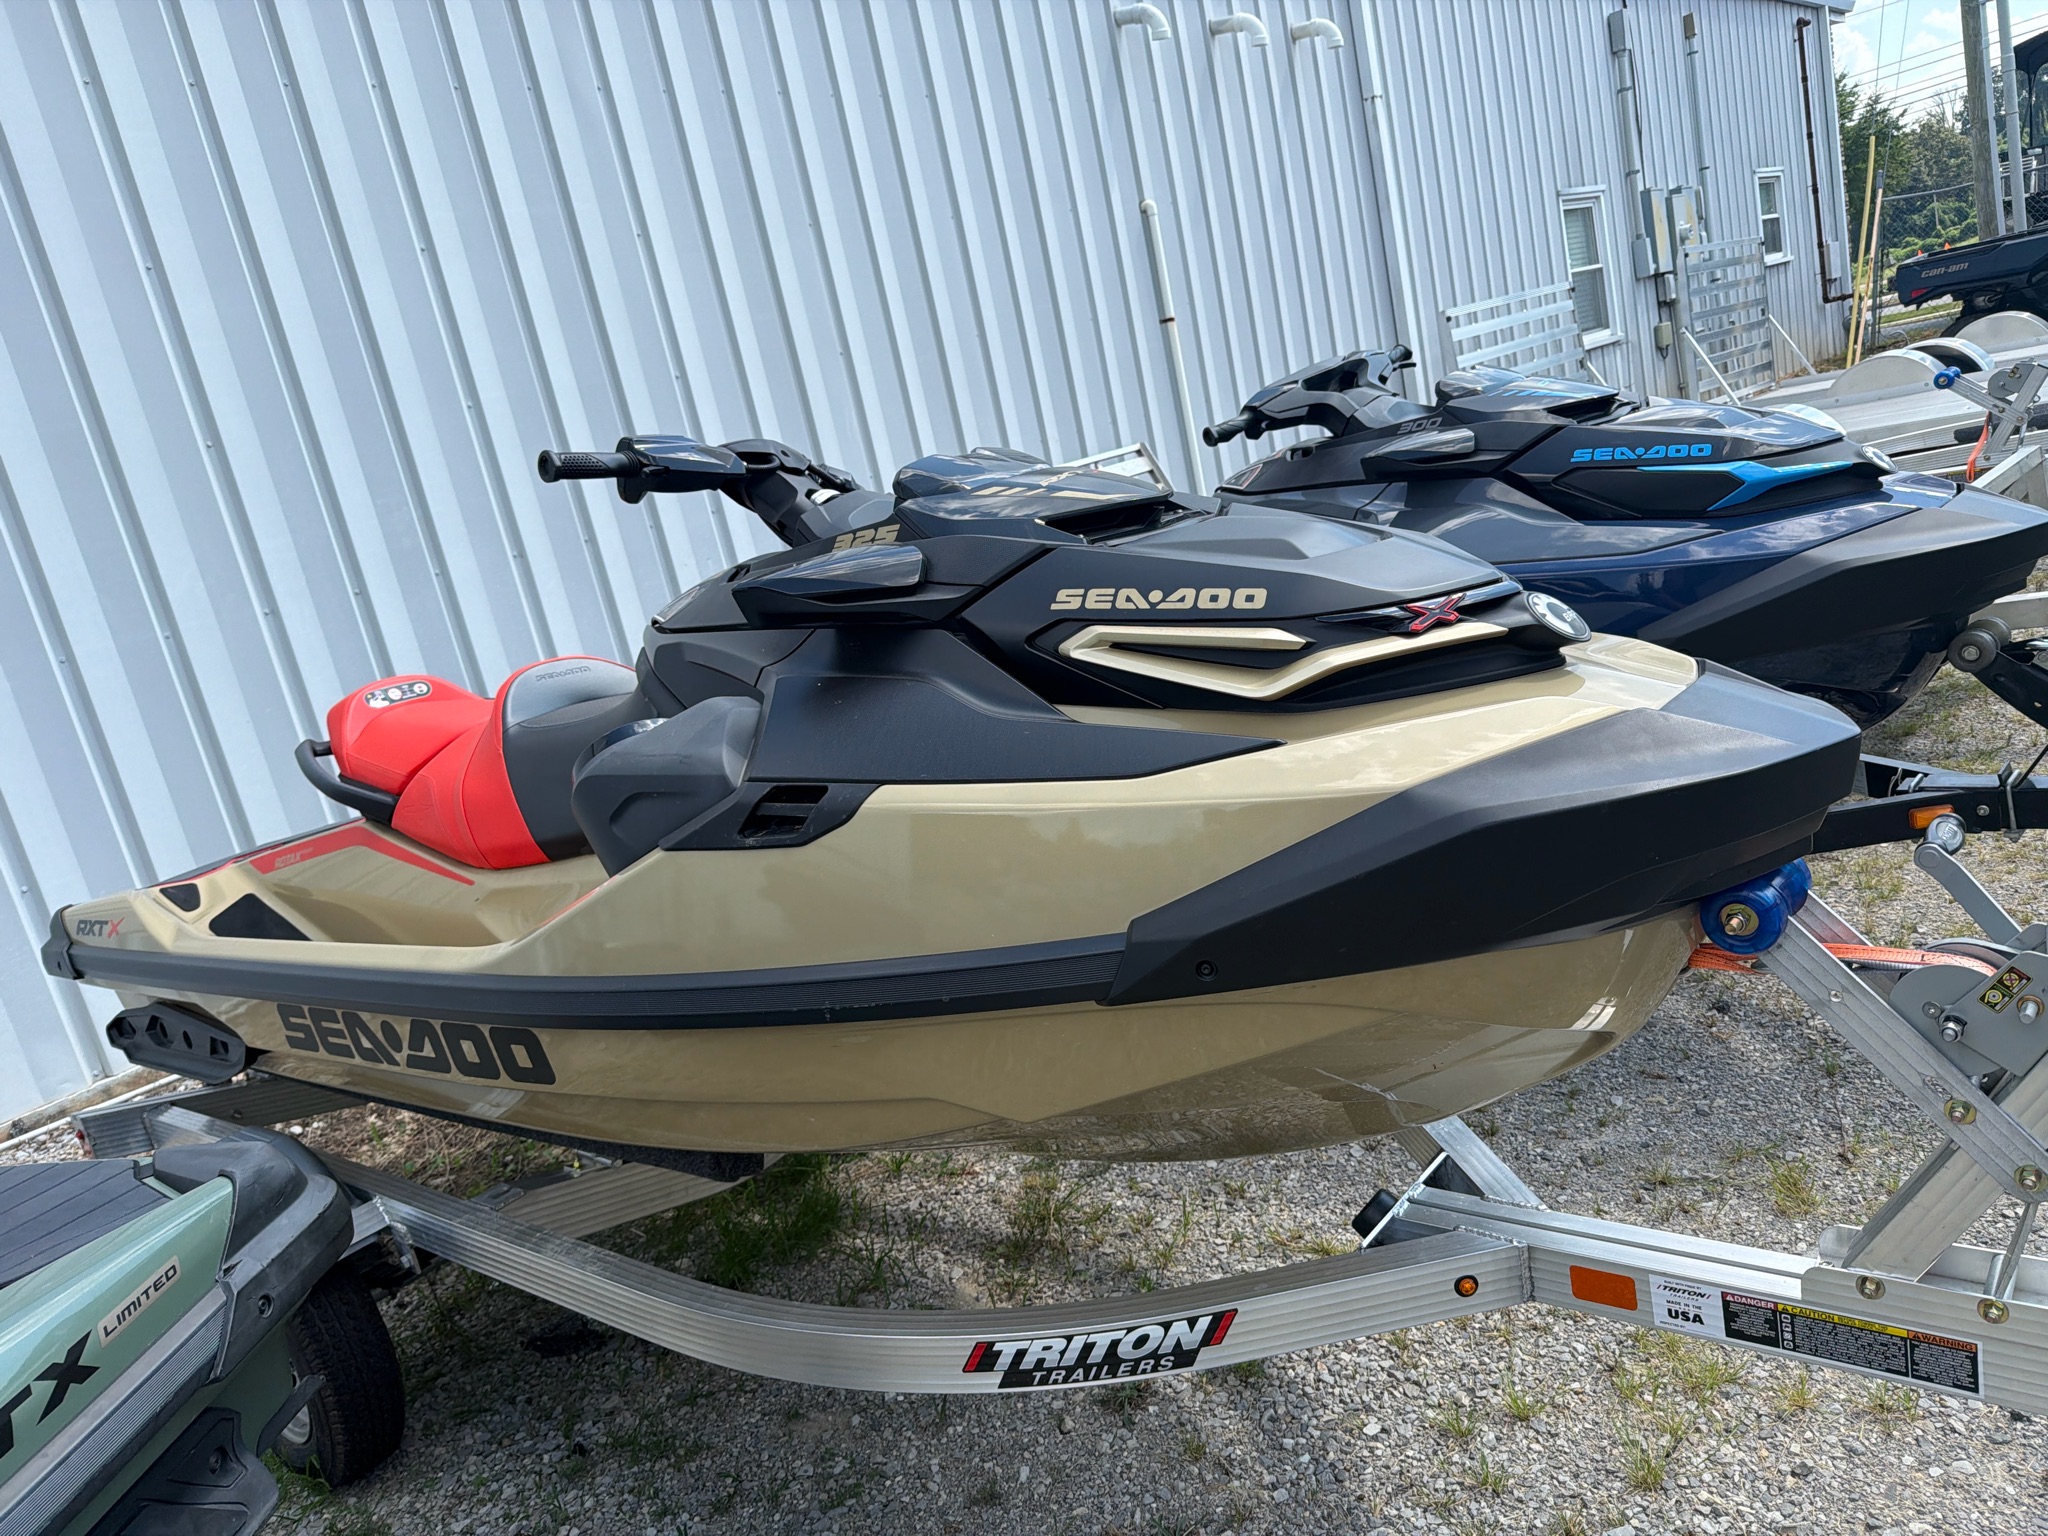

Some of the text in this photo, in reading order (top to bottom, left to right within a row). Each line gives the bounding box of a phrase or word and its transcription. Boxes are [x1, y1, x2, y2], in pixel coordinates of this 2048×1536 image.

[1921, 263, 1969, 278] can-am
[1397, 417, 1442, 434] 300
[832, 524, 900, 552] 325
[1662, 1285, 1706, 1298] TRITON
[103, 1264, 177, 1338] LIMITED
[1734, 1296, 1774, 1309] DANGER
[1667, 1308, 1705, 1325] USA
[1791, 1307, 1835, 1321] CAUTION
[992, 1315, 1213, 1371] TRITON
[1922, 1335, 1973, 1350] WARNING
[1032, 1355, 1175, 1386] TRAILERS
